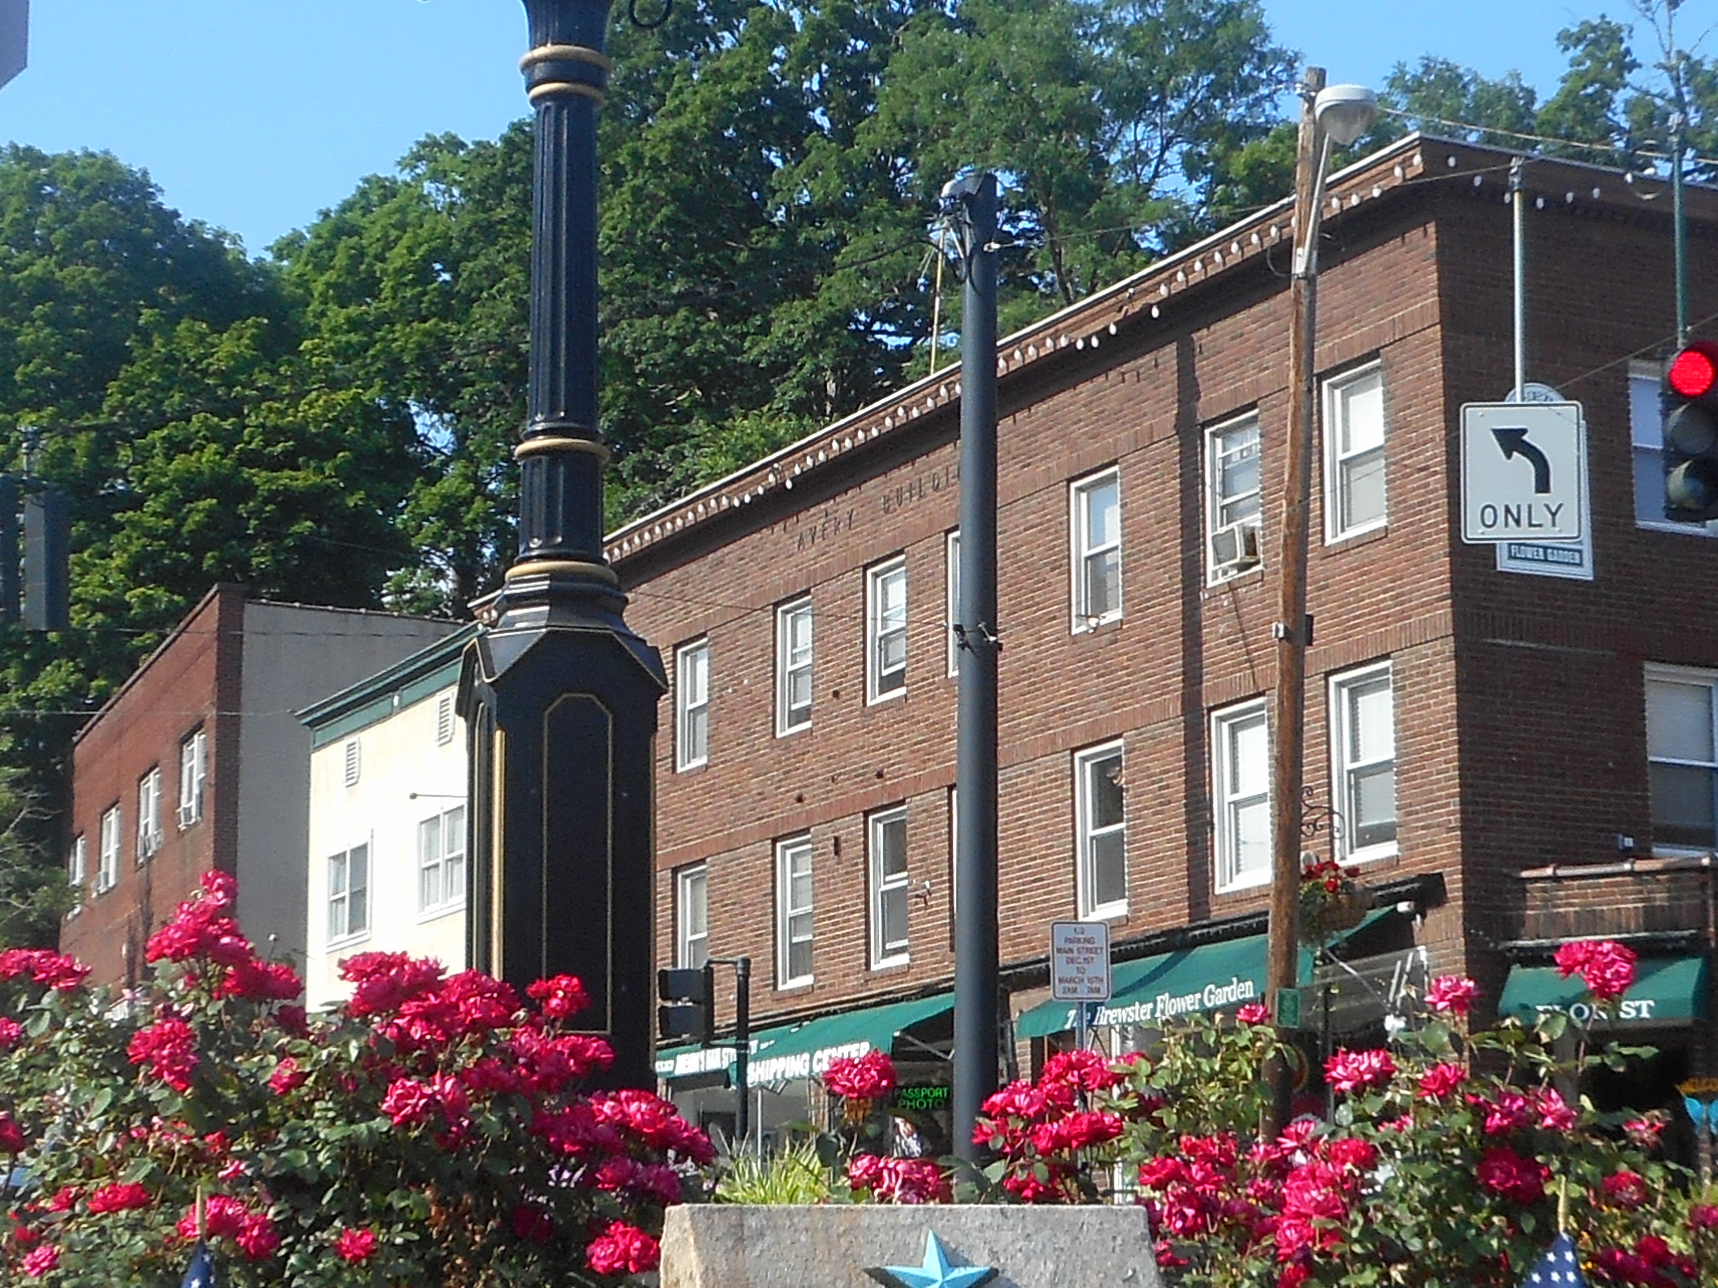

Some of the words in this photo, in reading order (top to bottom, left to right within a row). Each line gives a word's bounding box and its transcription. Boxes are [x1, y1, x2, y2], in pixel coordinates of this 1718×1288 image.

[797, 508, 855, 550] AVERY
[881, 465, 961, 514] BUILDI
[1480, 503, 1564, 529] ONLY
[1511, 544, 1545, 561] FLOWER
[1547, 549, 1581, 564] GARDEN
[1064, 936, 1095, 944] PARKING
[1076, 946, 1104, 954] STREET
[1076, 966, 1086, 974] TO
[1058, 976, 1084, 984] MARCH
[1064, 1009, 1091, 1029] Te
[1094, 1001, 1153, 1025] Brewster
[1155, 992, 1201, 1018] Flower
[1203, 977, 1254, 1008] Garden
[747, 1053, 810, 1087] SHIPPING
[894, 1087, 949, 1098] PASSPORT
[898, 1098, 945, 1110] PHOTO
